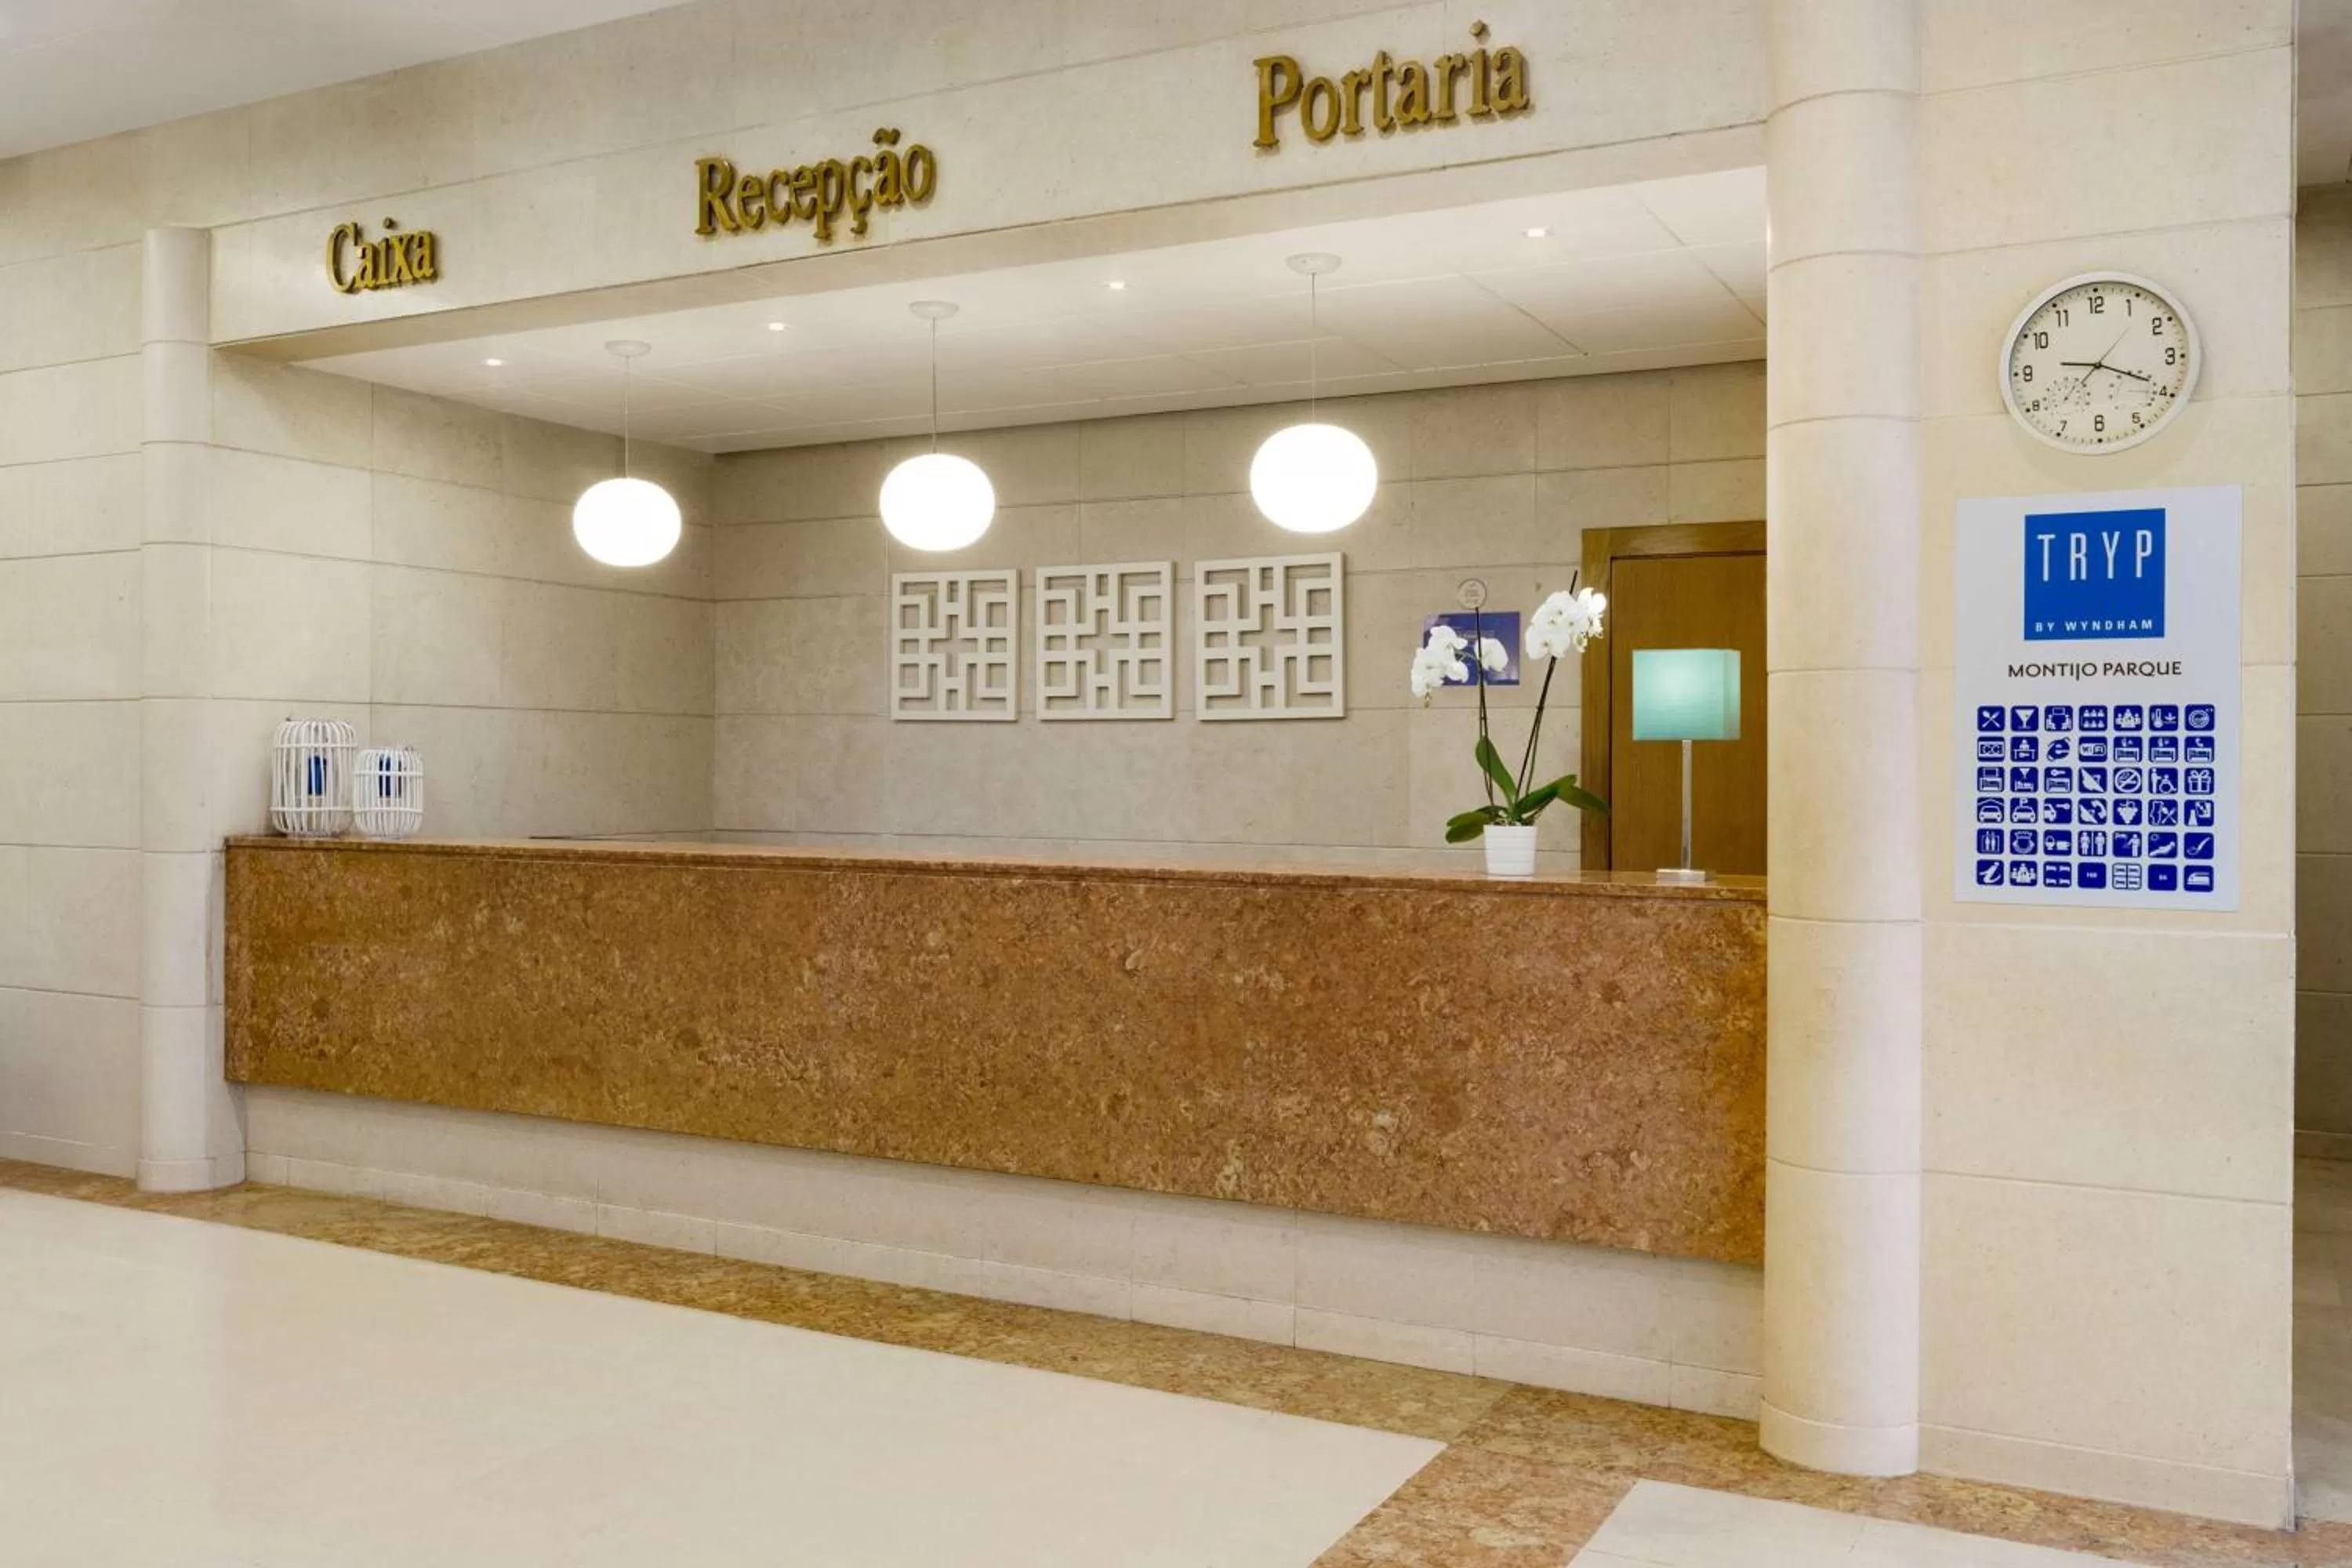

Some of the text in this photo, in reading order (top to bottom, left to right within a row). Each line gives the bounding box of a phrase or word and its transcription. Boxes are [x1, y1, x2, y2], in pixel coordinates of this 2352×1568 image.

[1252, 19, 1533, 149] Portaria
[695, 125, 936, 240] Recepção
[326, 216, 439, 293] Caixa
[2088, 296, 2104, 314] 12
[2126, 299, 2132, 317] 1
[2056, 310, 2068, 326] 11
[2152, 317, 2162, 335] 2
[2034, 332, 2049, 350] 10
[2165, 347, 2175, 365] 3
[2023, 365, 2033, 382] 9
[2159, 386, 2167, 397] 4
[2032, 400, 2039, 411] 8
[2060, 420, 2067, 431] 7
[2094, 415, 2104, 431] 6
[2132, 412, 2140, 423] 5
[2036, 529, 2153, 582] TRYP
[2034, 619, 2154, 633] BY WYNDHAM
[2008, 661, 2183, 681] MONTIJO PARQUE
